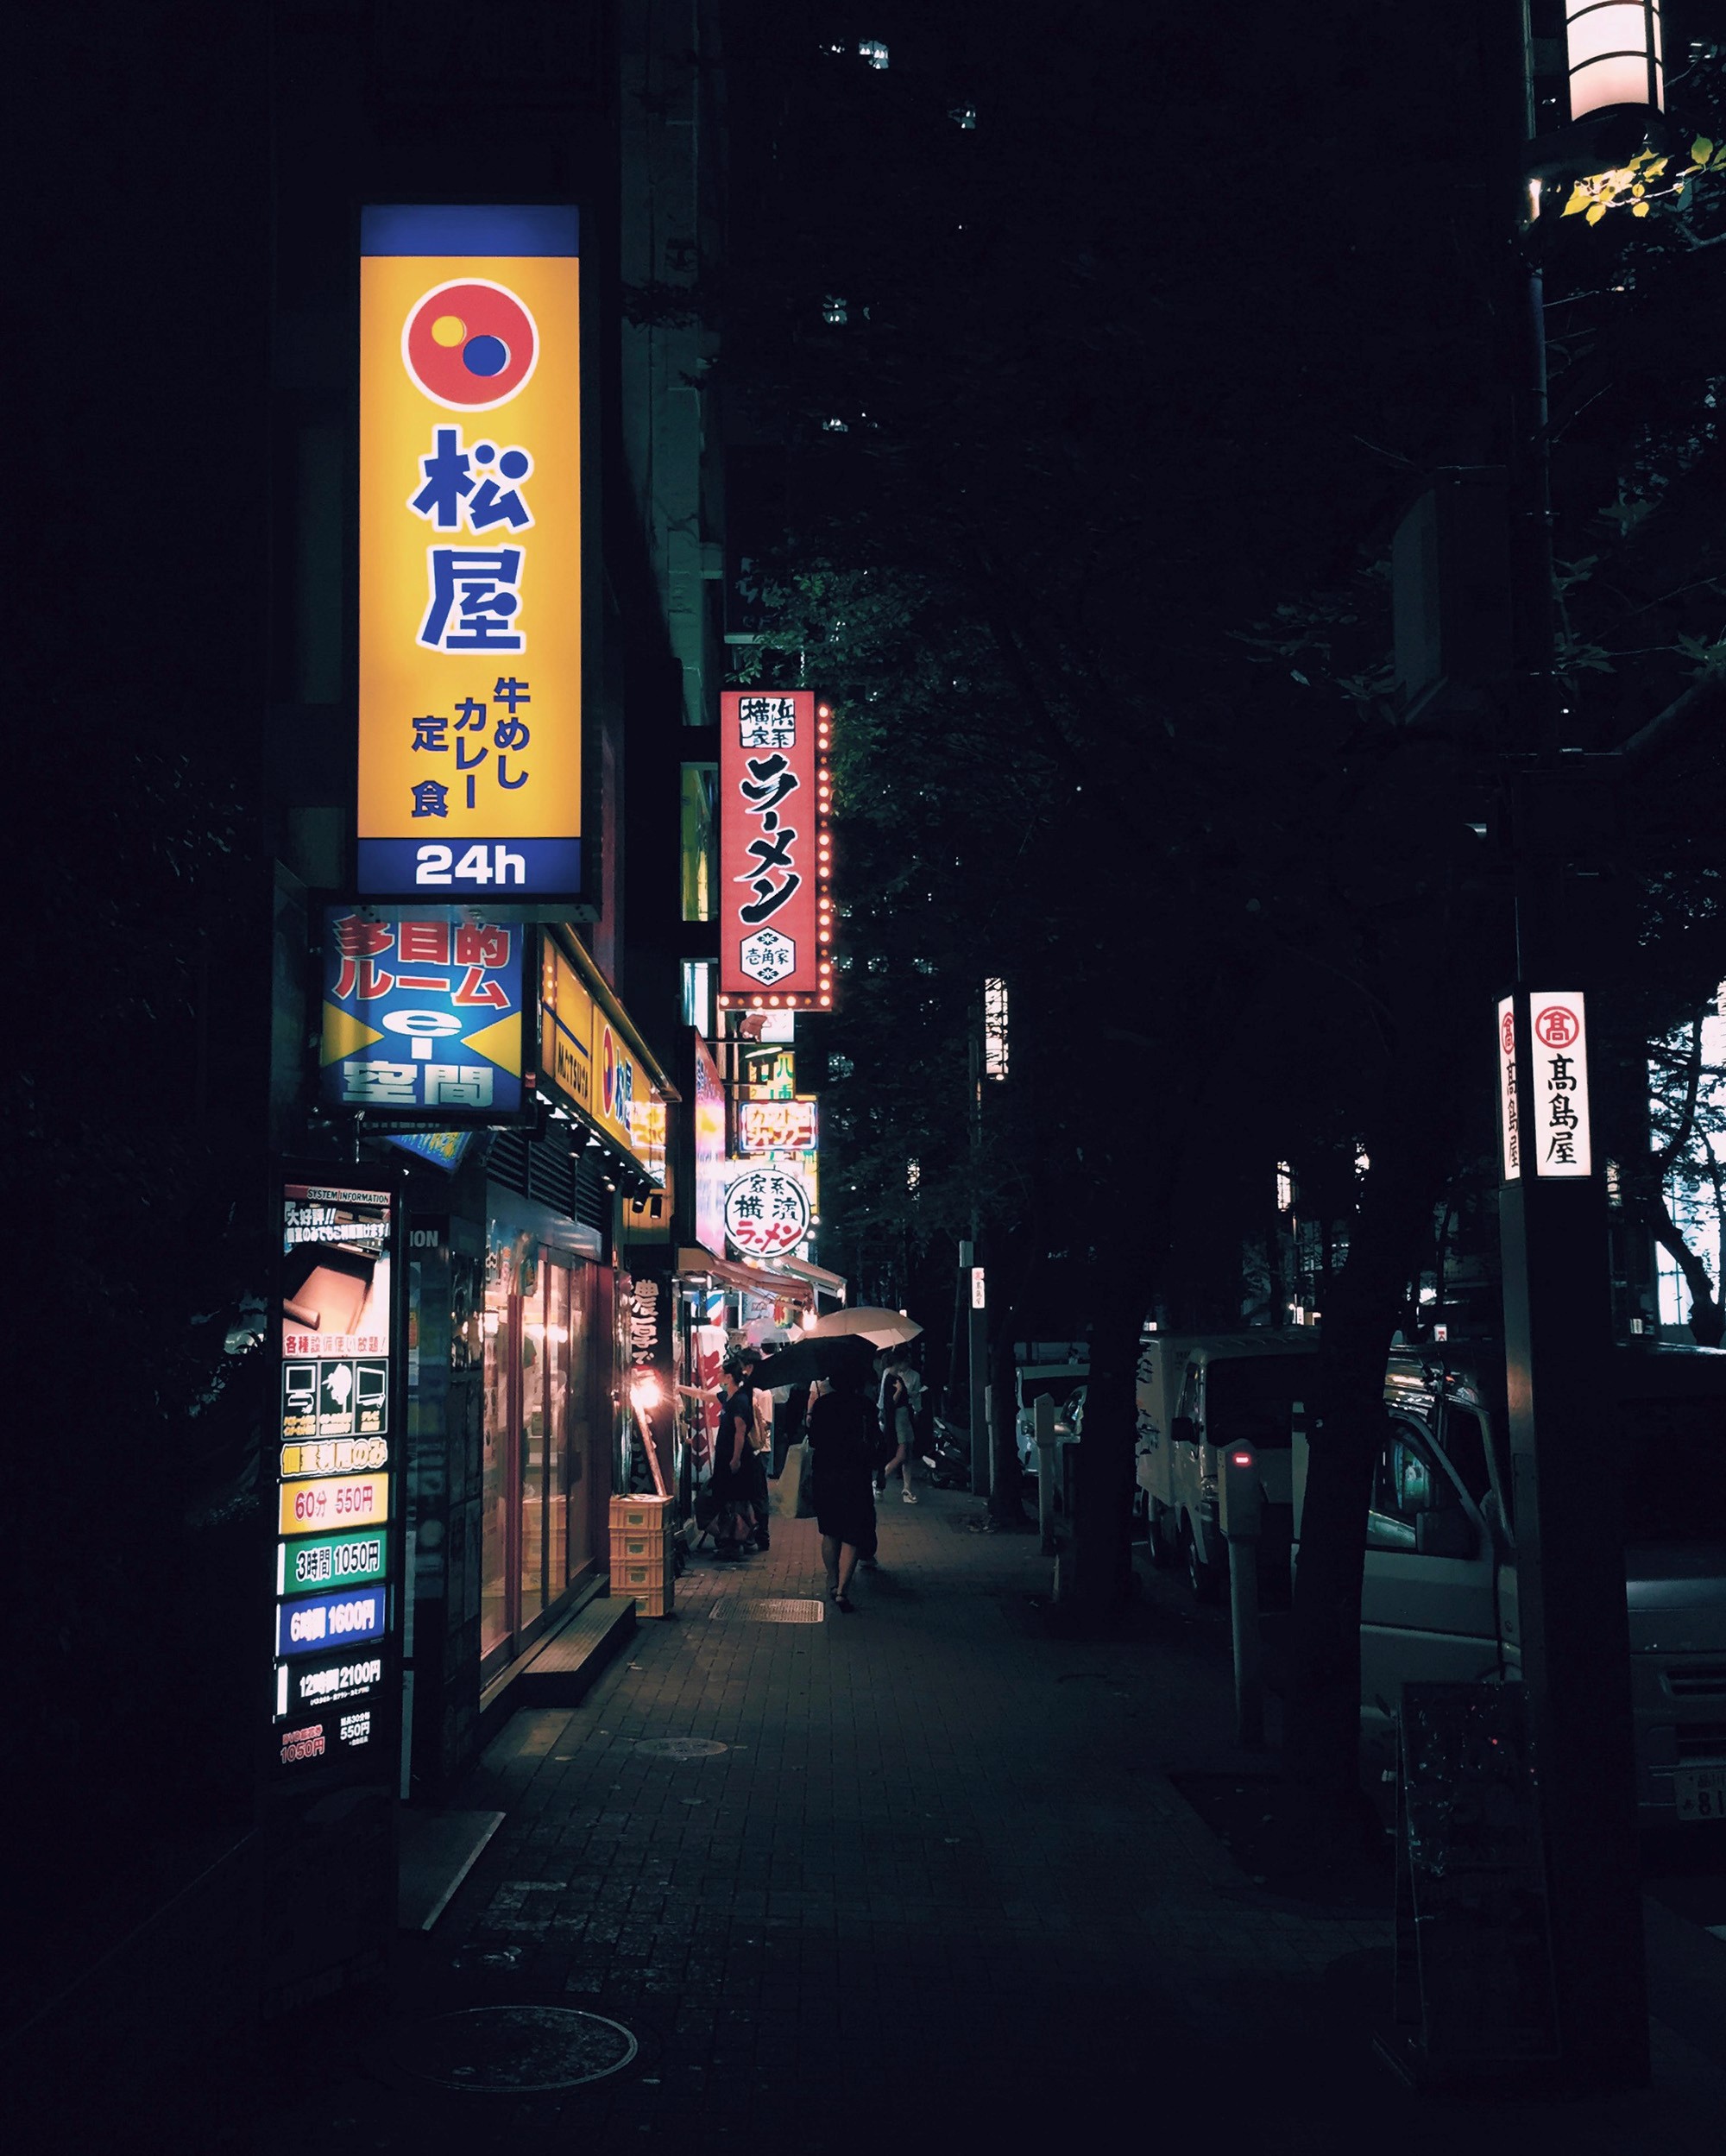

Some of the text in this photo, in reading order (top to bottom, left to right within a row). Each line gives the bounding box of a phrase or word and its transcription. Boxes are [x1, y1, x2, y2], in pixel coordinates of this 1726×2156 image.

[409, 426, 532, 652] 松屋
[453, 697, 488, 809] カレー
[494, 678, 531, 790] 牛めし
[411, 716, 449, 818] 定食
[736, 753, 801, 925] ラーメン
[416, 845, 526, 885] 24h
[333, 914, 511, 968] 多目的
[746, 949, 790, 965] 壱角家
[331, 957, 511, 1010] ルーム
[343, 1060, 493, 1107] 空間
[307, 1189, 388, 1203] SYSTEM INFORMATION
[750, 1174, 784, 1195] 家系
[736, 1220, 802, 1252] ラーメン
[295, 1485, 374, 1521] 60分 550円
[296, 1541, 380, 1581] 3時間 1050円
[329, 1599, 375, 1634] 1600円
[340, 1659, 381, 1688] 2100円
[280, 1737, 325, 1764] 1050円
[340, 1721, 370, 1740] 550円
